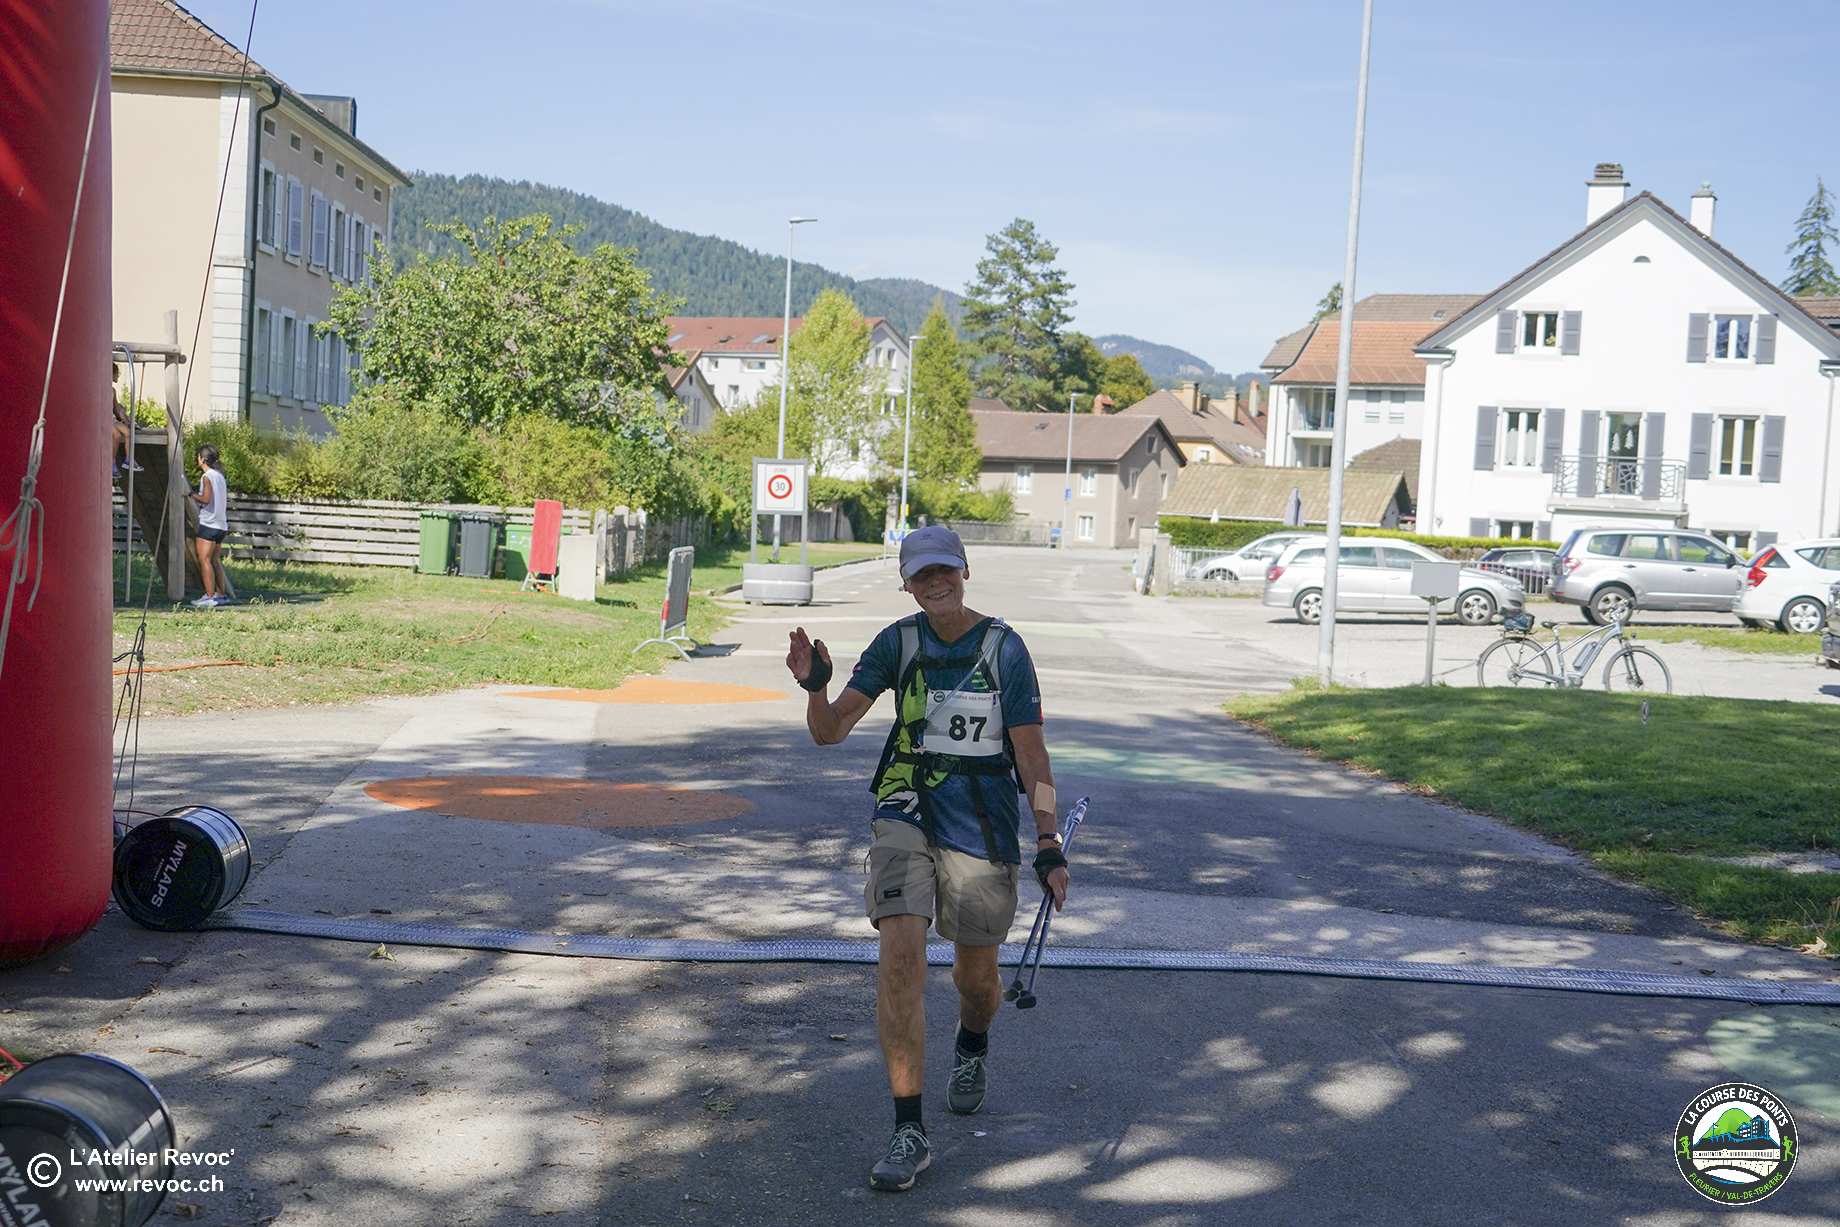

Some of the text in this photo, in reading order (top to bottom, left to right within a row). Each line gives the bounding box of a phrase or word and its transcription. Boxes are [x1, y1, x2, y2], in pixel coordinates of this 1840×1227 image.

[775, 482, 785, 491] 30
[949, 714, 987, 742] 87
[151, 840, 187, 907] MYLAPS
